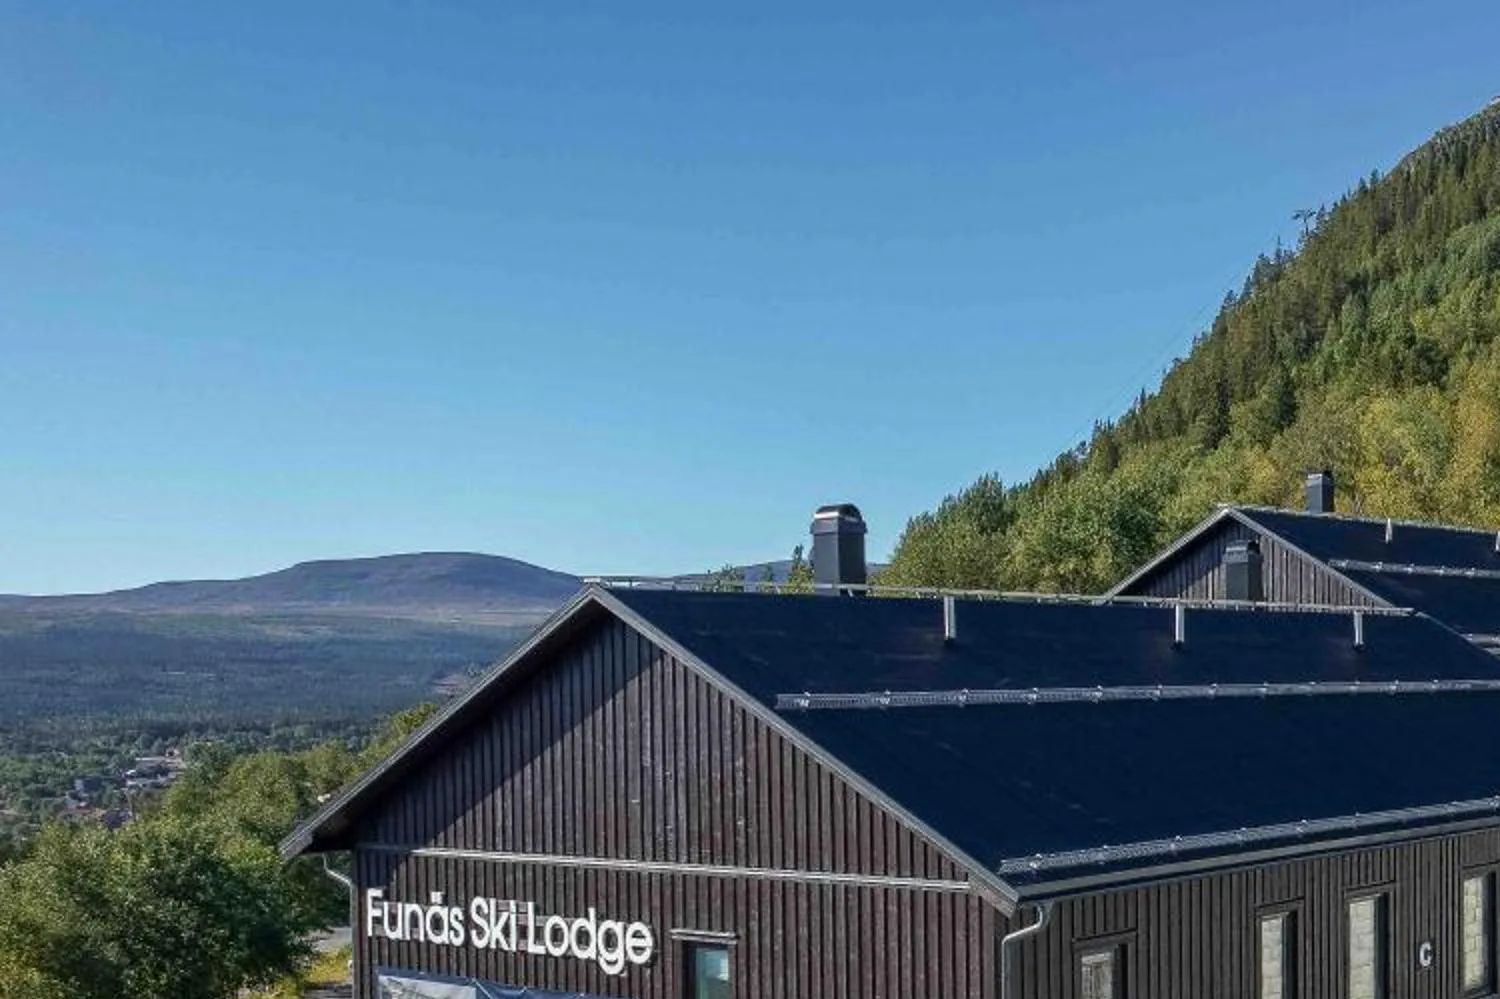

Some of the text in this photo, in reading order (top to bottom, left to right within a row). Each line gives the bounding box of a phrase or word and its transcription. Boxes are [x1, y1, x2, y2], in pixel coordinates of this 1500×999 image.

[470, 896, 517, 952] Ski
[527, 901, 653, 975] Lodge
[1420, 942, 1432, 967] C
